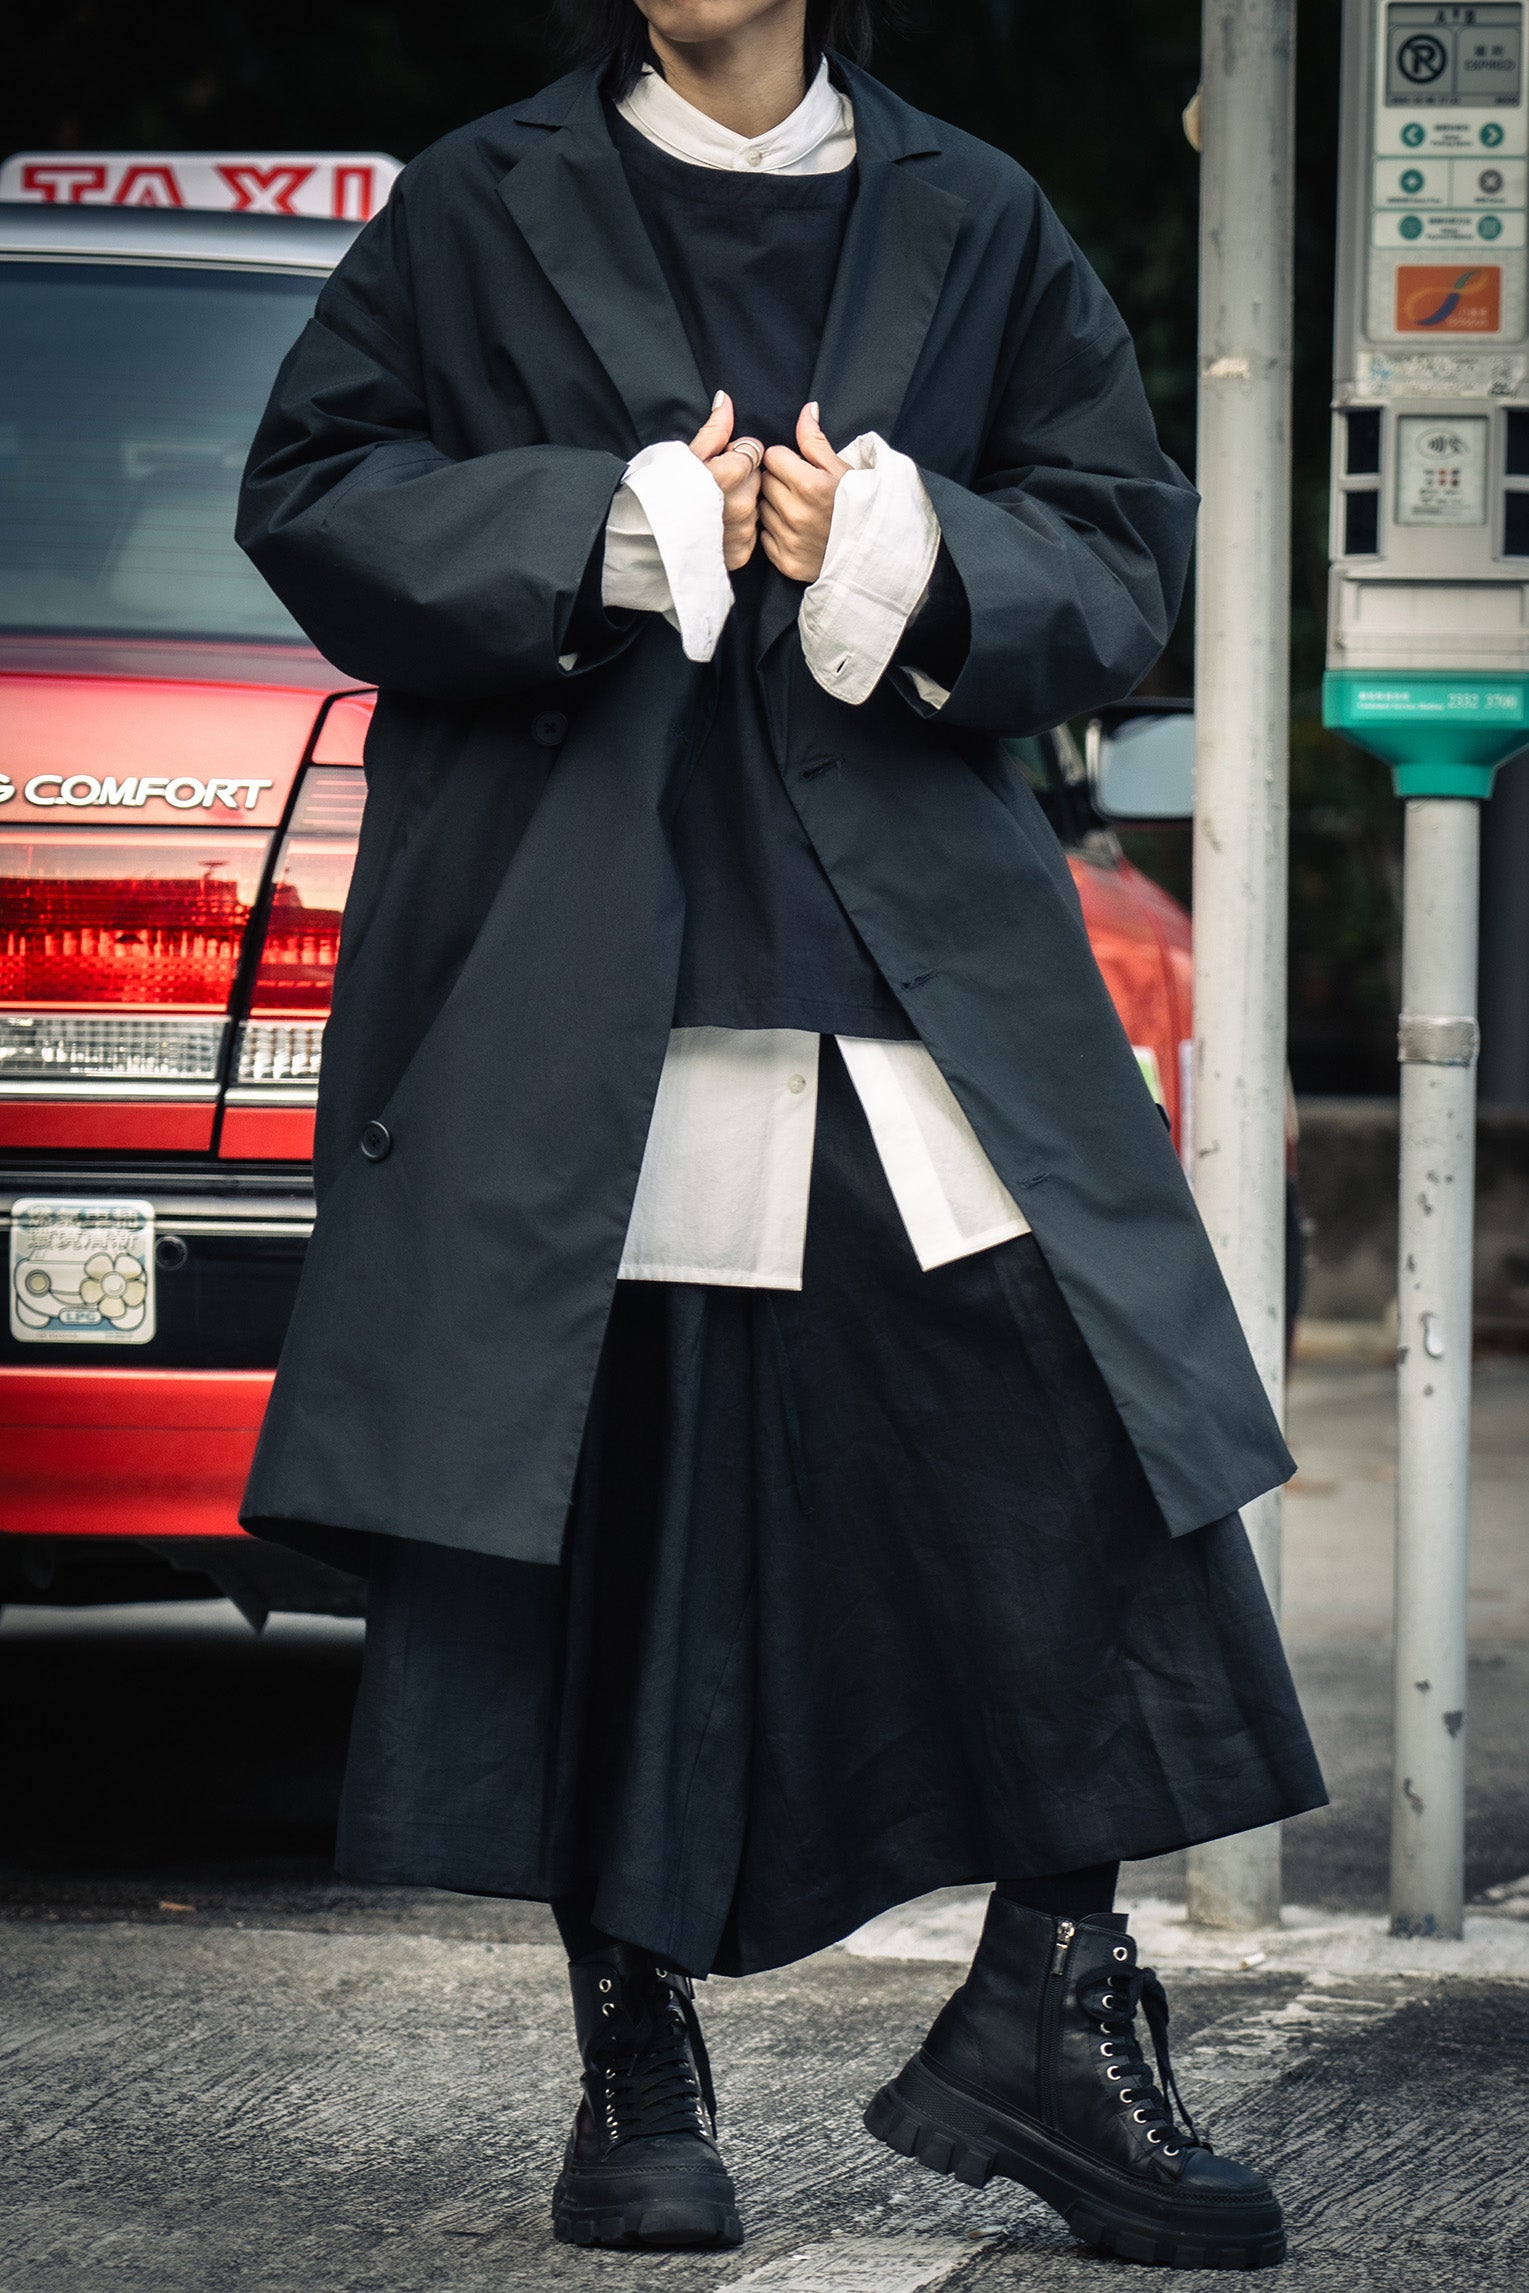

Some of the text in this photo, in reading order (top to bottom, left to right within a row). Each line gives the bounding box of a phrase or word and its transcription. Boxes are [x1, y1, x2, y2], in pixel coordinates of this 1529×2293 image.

[22, 163, 374, 222] TAXI
[24, 774, 273, 809] COMFORT
[65, 1311, 96, 1322] LPG
